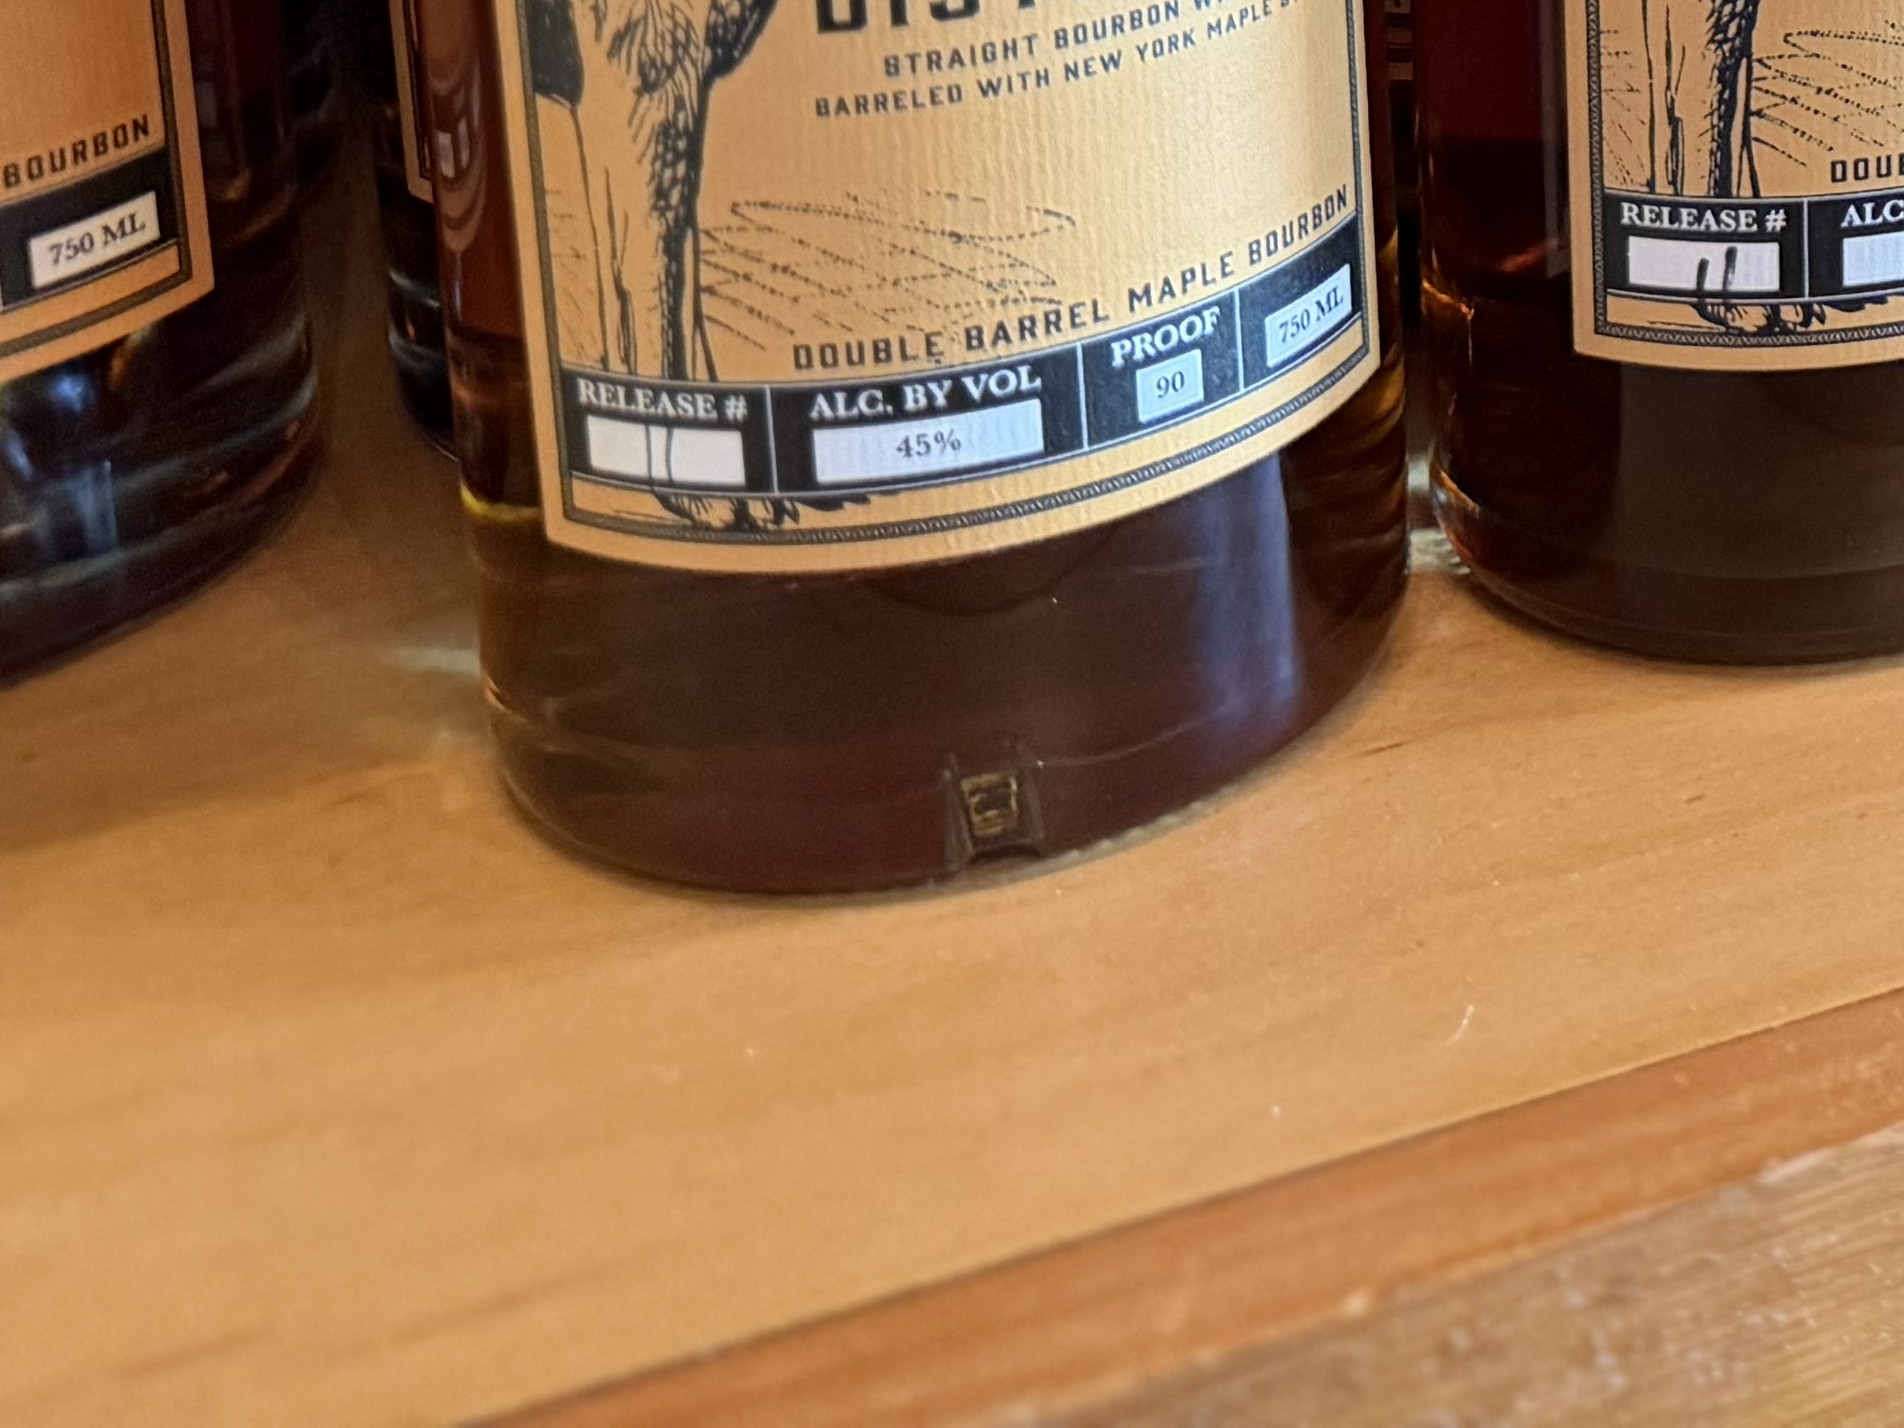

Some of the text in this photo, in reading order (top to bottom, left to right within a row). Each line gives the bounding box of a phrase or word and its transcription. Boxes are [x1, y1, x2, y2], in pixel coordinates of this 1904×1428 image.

[885, 33, 1039, 77] STRAIGHT
[1054, 0, 1180, 50] BOURBON
[816, 83, 963, 117] BARRELED
[977, 69, 1050, 98] WITH
[1064, 51, 1123, 81] NEW
[1136, 27, 1197, 64] YORK
[2, 114, 150, 188] BOURBON
[49, 212, 146, 266] 750 ML
[1621, 202, 1786, 233] RELEASE #
[793, 183, 1347, 371] DOUBLE BARREL MAPLE BOURBON
[1111, 306, 1222, 367] PROOF
[1278, 285, 1345, 344] 750 ML
[577, 378, 747, 419] RELEASE #
[810, 364, 1042, 420] ALC. BY VOL
[1156, 372, 1185, 398] 90
[897, 427, 962, 459] 45%
